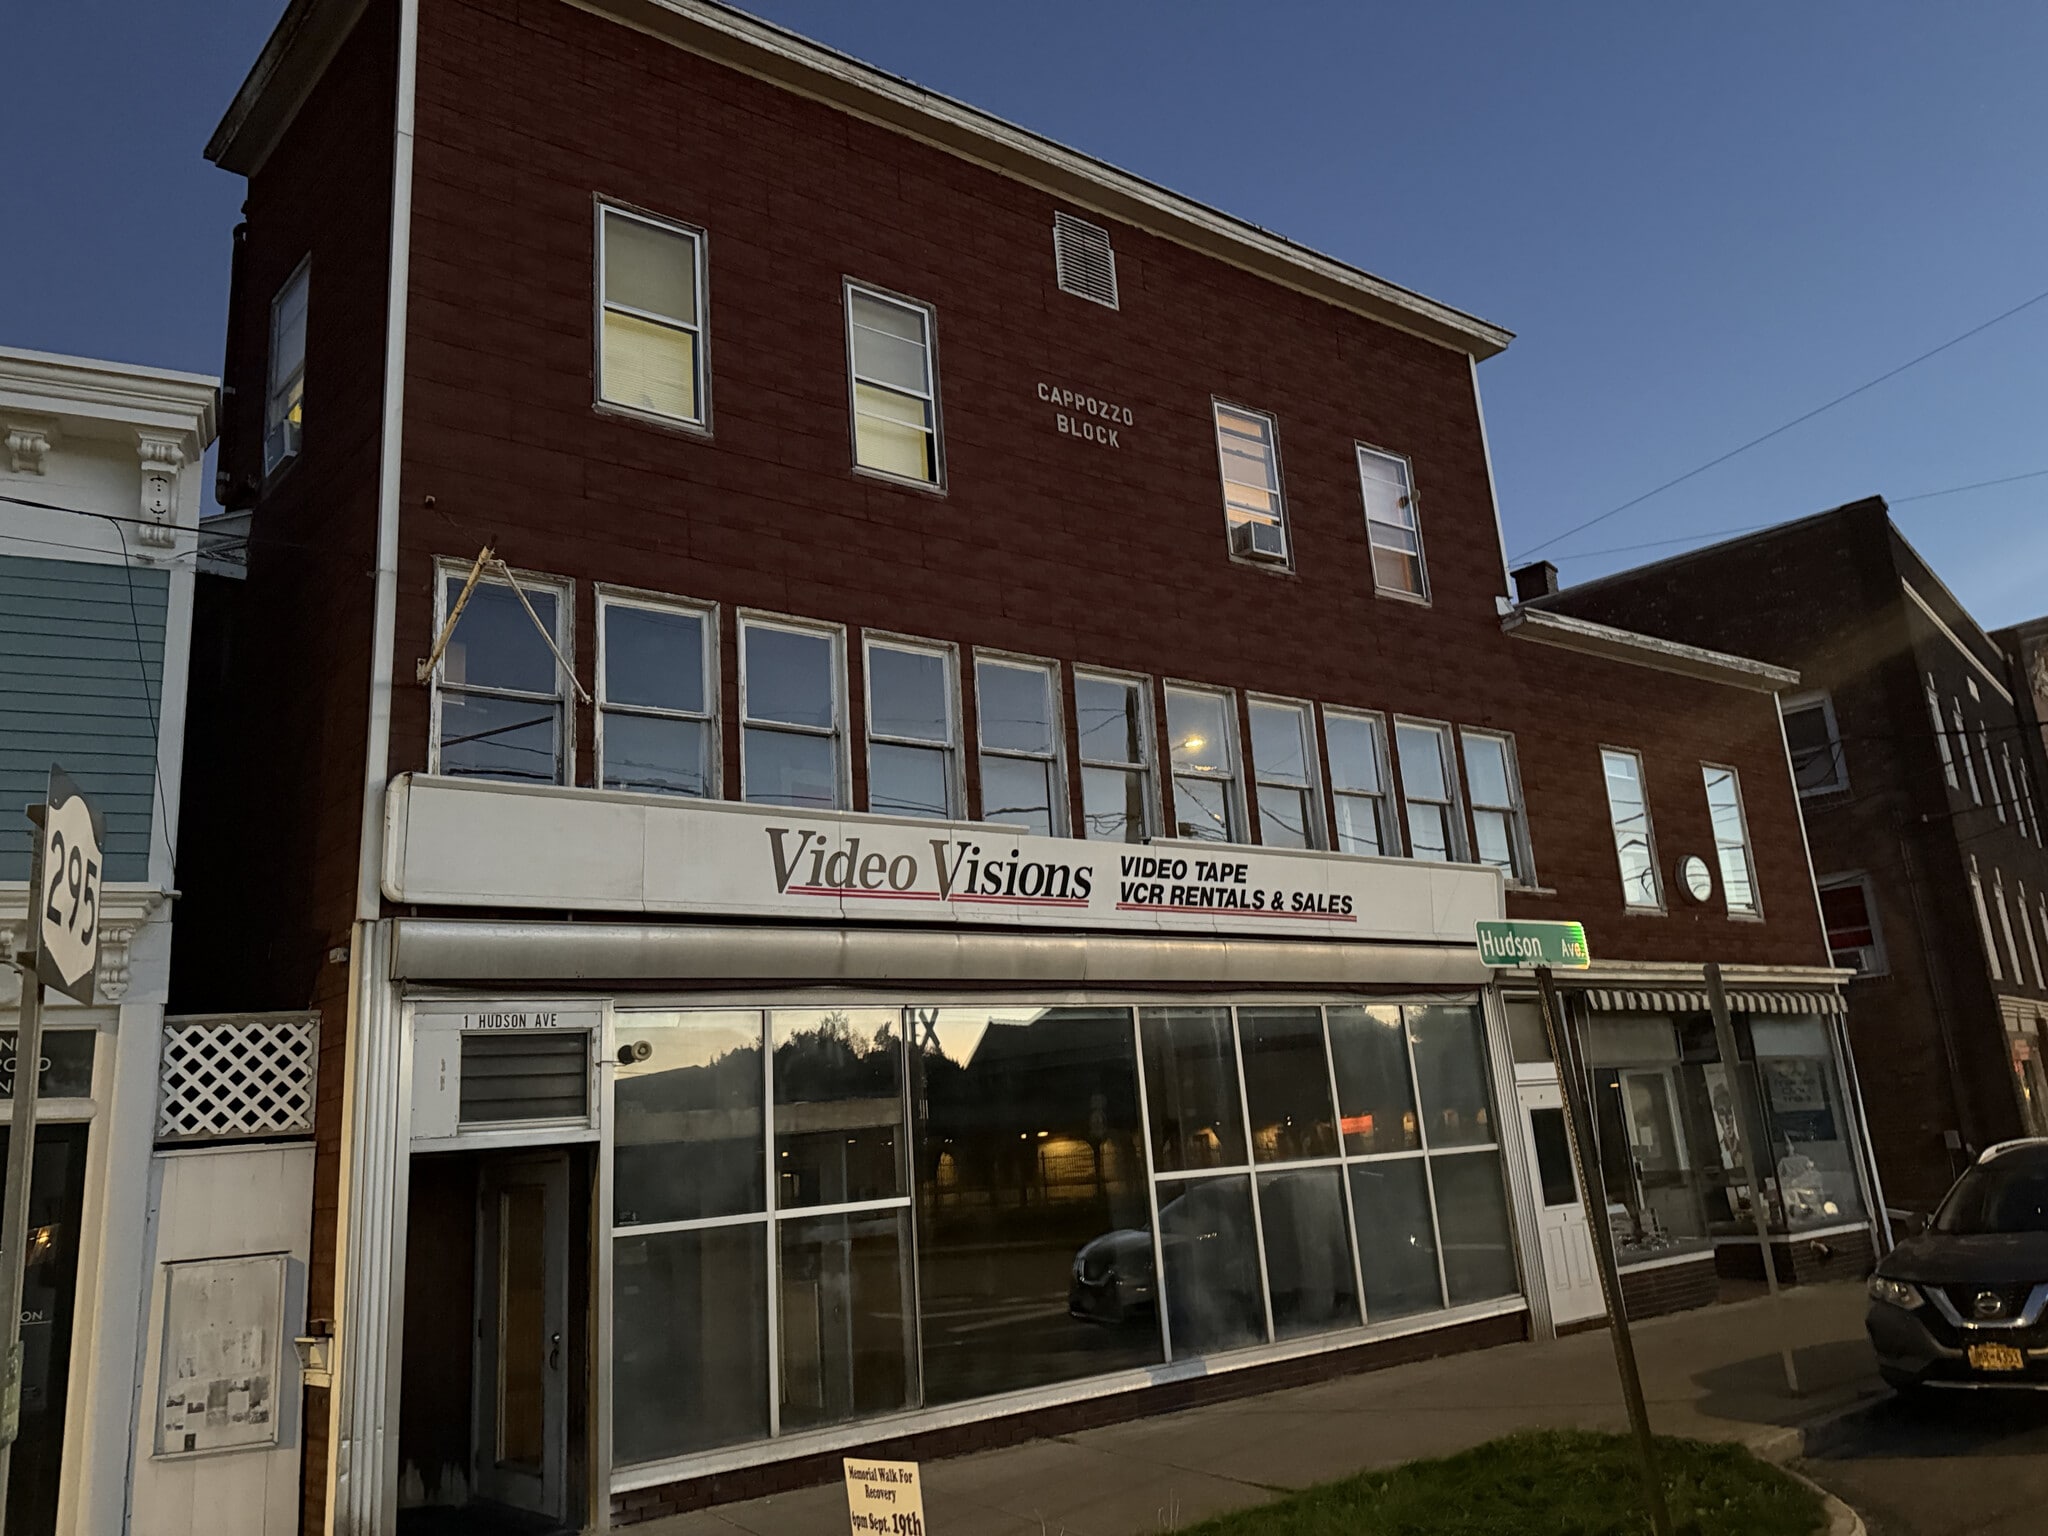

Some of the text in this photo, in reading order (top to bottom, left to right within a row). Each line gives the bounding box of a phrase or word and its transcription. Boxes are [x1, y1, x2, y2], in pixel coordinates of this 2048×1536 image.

[1037, 382, 1134, 426] CAPPOZZO
[1056, 413, 1120, 448] BLOCK
[765, 827, 1093, 902] Video Visions
[1120, 855, 1248, 884] VIDEO TAPE
[46, 829, 98, 946] 295
[1120, 881, 1353, 915] VCR RENTALS & SALES
[1480, 929, 1543, 958] Hudson
[463, 1013, 557, 1029] 1 HUDSON AVE
[848, 1465, 913, 1484] Memorial Walk For
[864, 1484, 896, 1504] Recovery
[868, 1512, 891, 1536] Sept.
[892, 1511, 922, 1536] 19th
